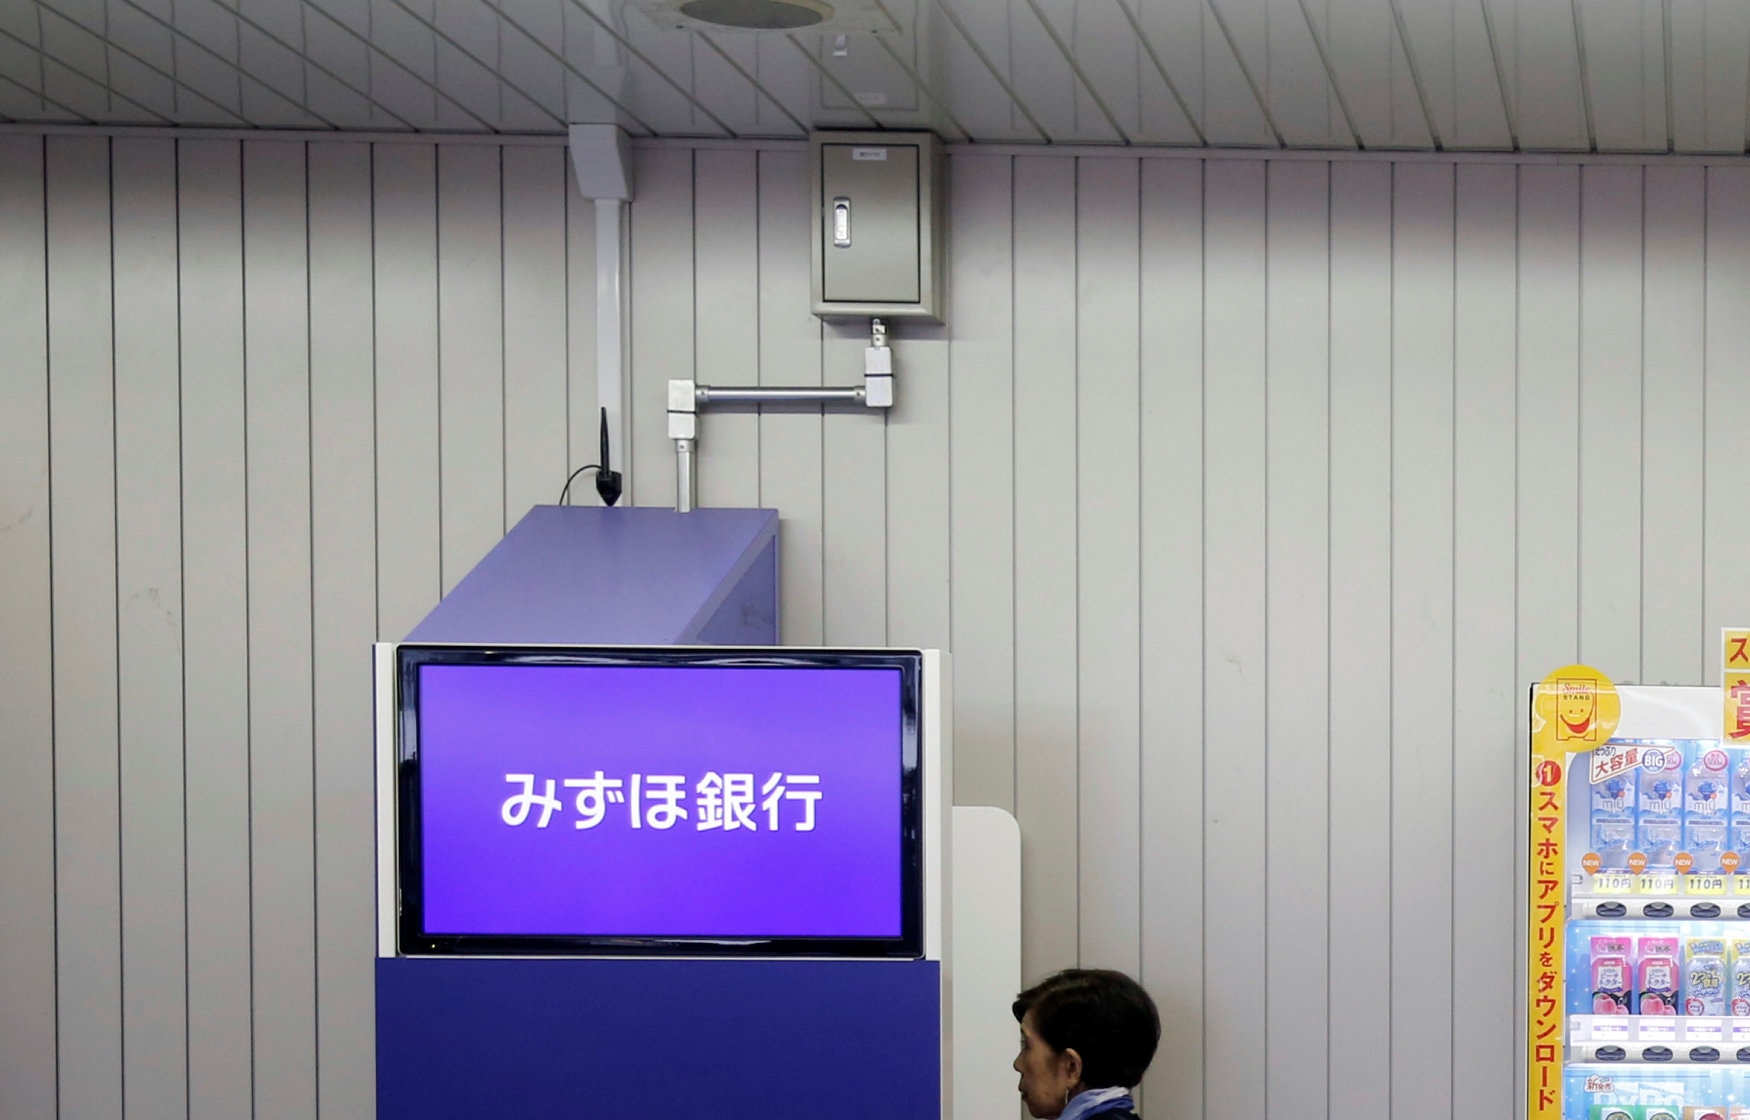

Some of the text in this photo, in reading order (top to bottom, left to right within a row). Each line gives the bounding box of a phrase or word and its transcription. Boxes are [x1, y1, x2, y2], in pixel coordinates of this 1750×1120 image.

[1562, 682, 1591, 693] Smile
[1595, 748, 1638, 778] 大容量
[1644, 756, 1663, 767] BIG
[501, 770, 823, 831] みずほ銀行
[1582, 858, 1600, 867] NEW
[1628, 858, 1646, 867] NEW
[1675, 858, 1692, 867] NEW
[1721, 857, 1739, 867] NEW
[1597, 878, 1632, 889] 110円
[1641, 878, 1674, 890] 110円
[1690, 878, 1723, 890] 110円
[1535, 791, 1560, 1111] スマホにアプリをダウンロード
